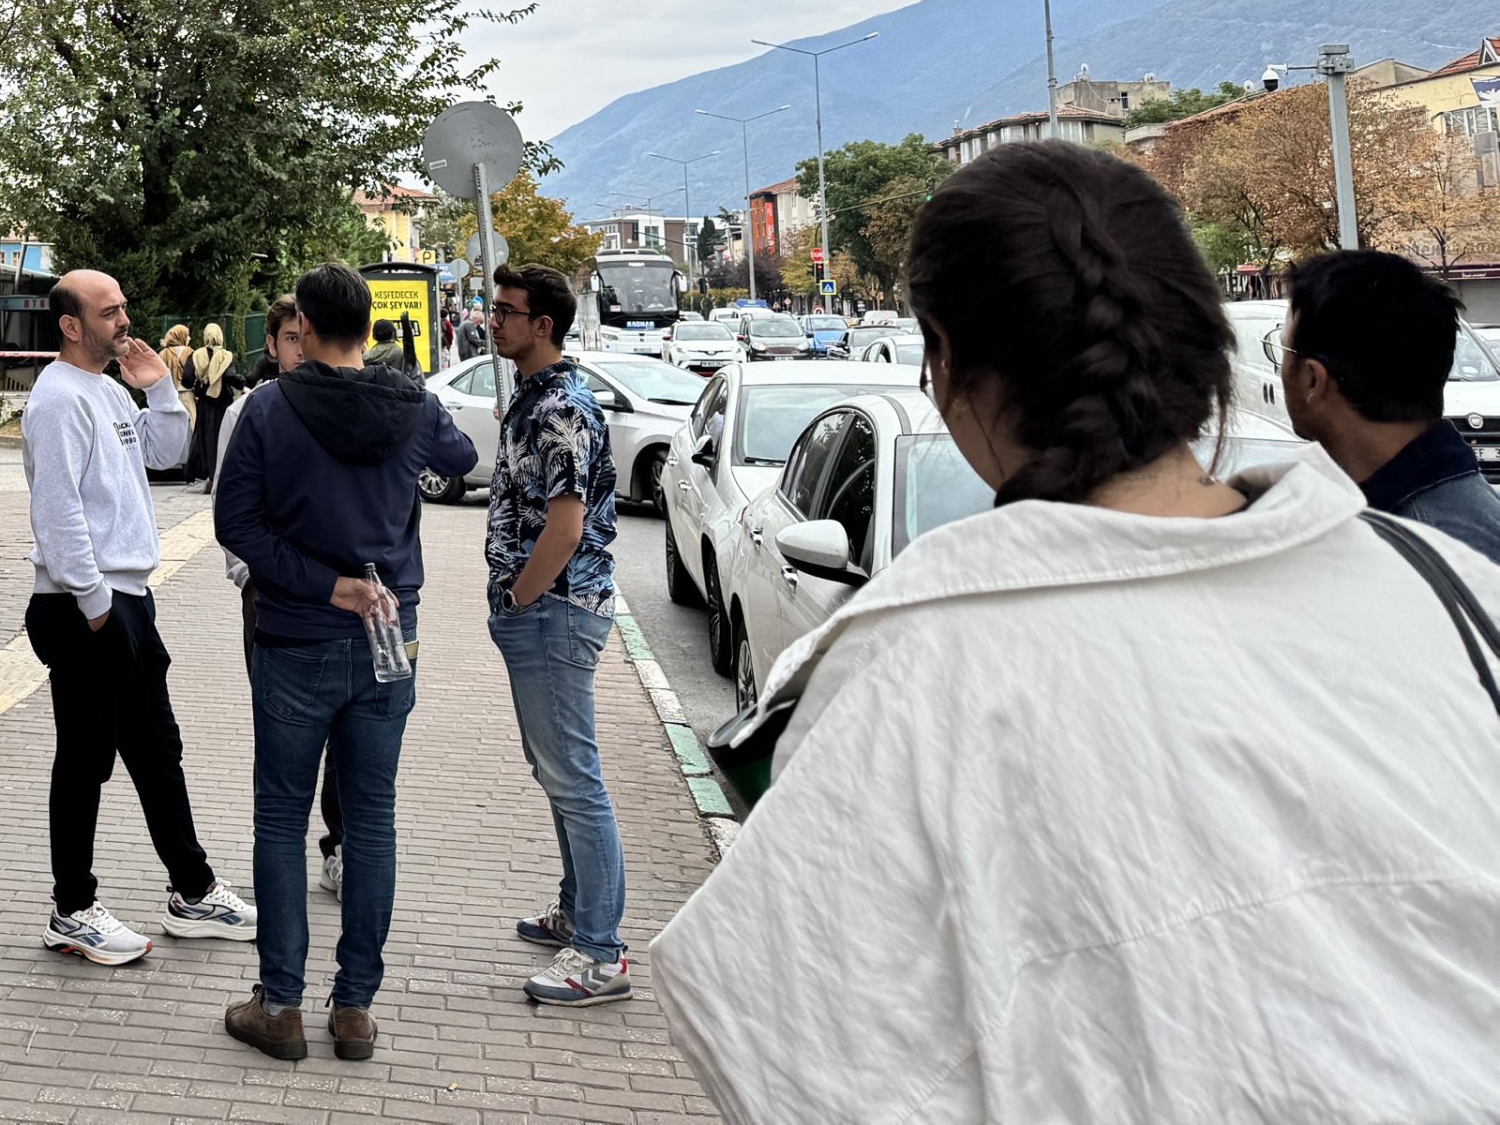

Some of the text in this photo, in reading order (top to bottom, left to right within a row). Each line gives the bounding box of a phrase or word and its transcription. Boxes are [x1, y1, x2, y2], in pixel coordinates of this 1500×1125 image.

[374, 290, 419, 300] KEŞFEDECEK
[372, 301, 388, 310] ÇOK
[389, 301, 404, 310] ŞEY
